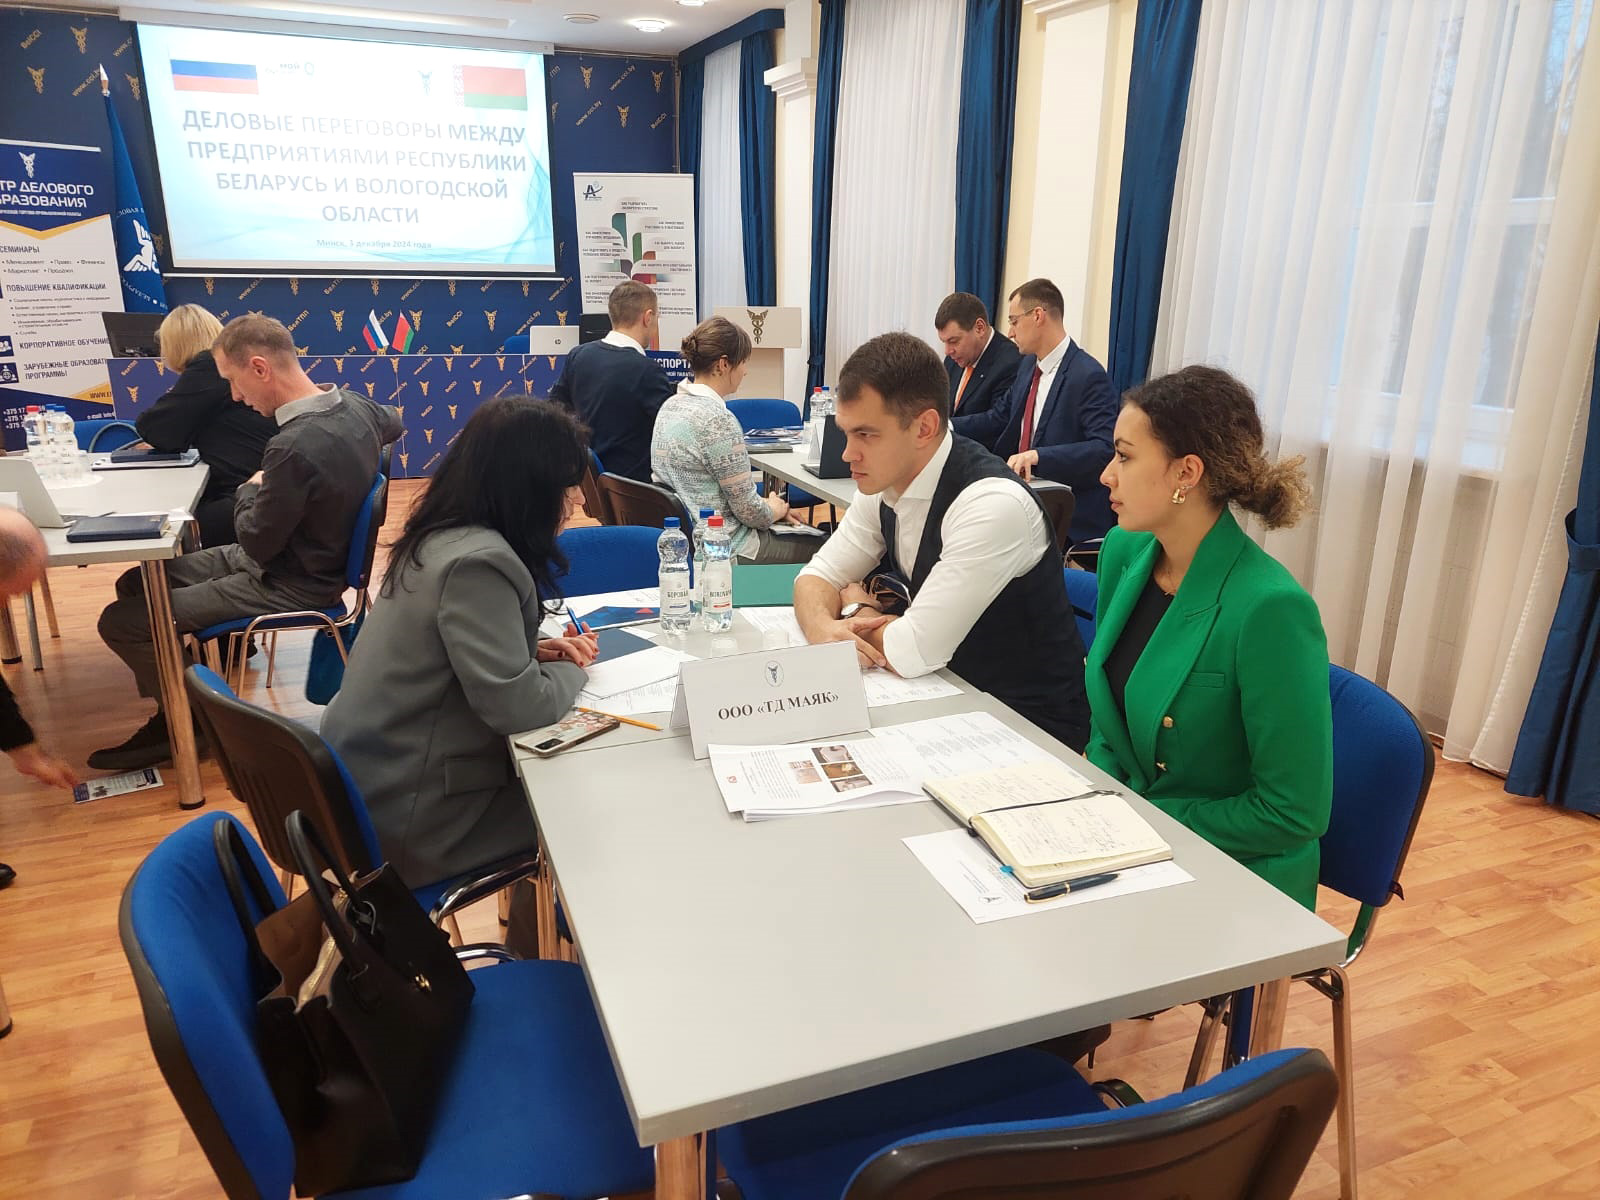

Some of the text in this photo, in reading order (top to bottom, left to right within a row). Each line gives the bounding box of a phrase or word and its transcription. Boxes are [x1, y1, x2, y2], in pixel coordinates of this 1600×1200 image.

[182, 109, 525, 146] ДЕЛОВЫЕ ПЕРЕГОВОРЫ МЕЖДУ
[187, 141, 526, 171] ПРЕДПРИЯТИЯМИ РЕСПУБЛИКИ
[20, 181, 94, 196] ДЕЛОВОГО
[216, 172, 508, 200] БЕЛАРУСЬ И ВОЛОГОДСКОЙ
[0, 194, 87, 208] РАЗОВАНИЯ
[322, 205, 419, 223] ОБЛАСТИ
[316, 239, 348, 248] Минск,
[356, 240, 391, 249] декабря
[413, 241, 432, 249] года
[6, 282, 107, 292] ПОВЫШЕНИЕ КВАЛИФИКАЦИИ
[19, 340, 76, 349] КОРПОРАТИВНОЕ
[23, 358, 107, 371] ЗАРУБЕЖНЫЕ ОБРАЗОВАТ
[654, 358, 692, 369] СПОРТ
[25, 371, 68, 380] ПРОГРАММЫ
[718, 691, 839, 720] ООО «ТД МАЯК»
